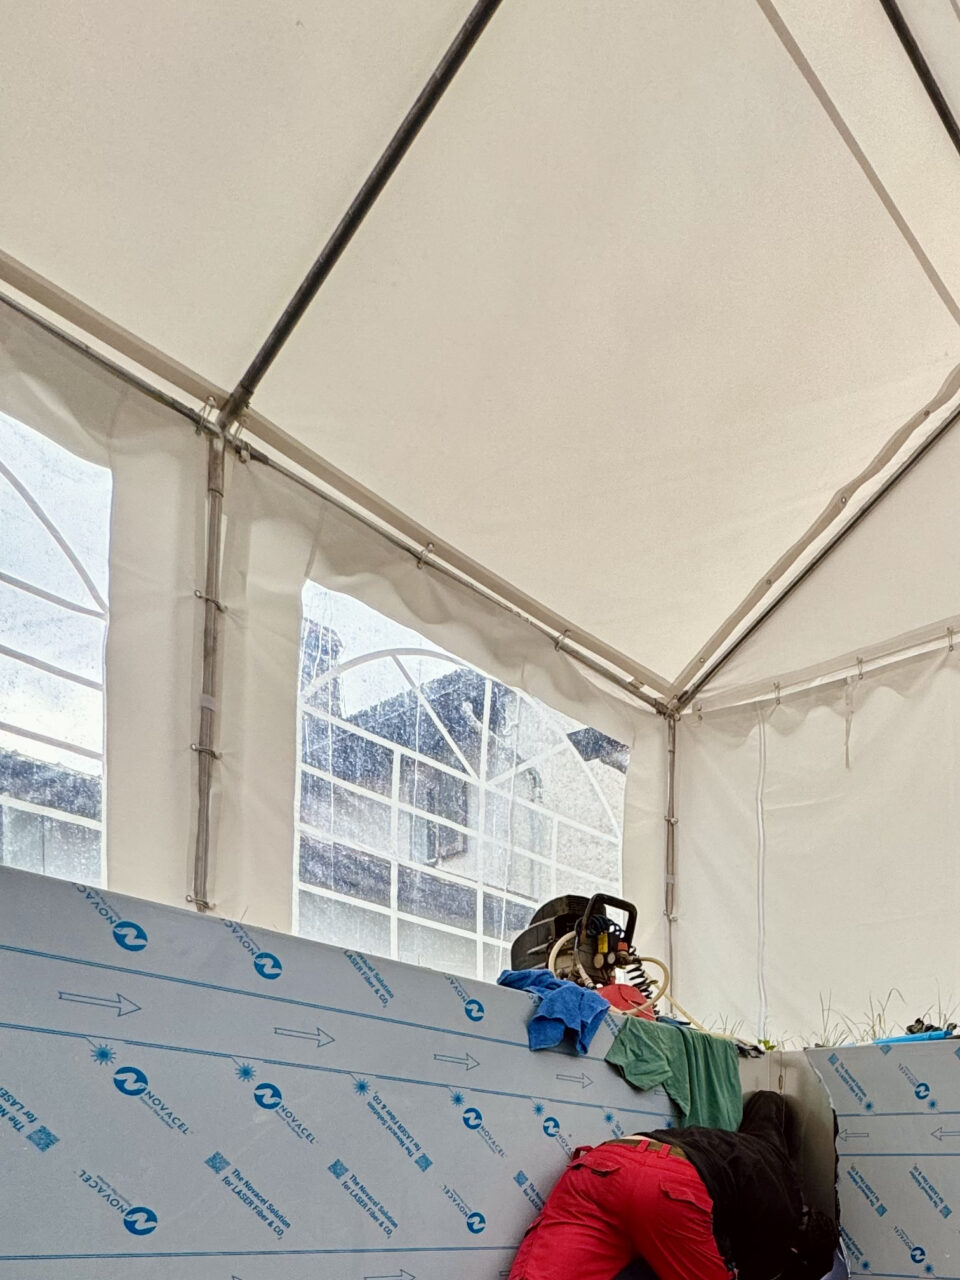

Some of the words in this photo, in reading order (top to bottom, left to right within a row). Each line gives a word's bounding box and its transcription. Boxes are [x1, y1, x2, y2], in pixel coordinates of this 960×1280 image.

[71, 881, 117, 925] NOVAC
[7, 1115, 24, 1132] The
[144, 1090, 188, 1135] NOVACEL
[278, 1104, 315, 1144] NOVACEL
[478, 1122, 504, 1157] NOVACEL
[78, 1169, 129, 1213] NOVACEL
[230, 1184, 254, 1207] LASER
[251, 1204, 269, 1222] Fiber
[242, 1180, 269, 1206] Novacel
[265, 1203, 291, 1228] Solution
[348, 1188, 368, 1209] LASER
[365, 1207, 380, 1222] Fiber
[357, 1184, 380, 1208] Novacel
[377, 1204, 398, 1229] Solution
[442, 1184, 472, 1219] NOVACEL
